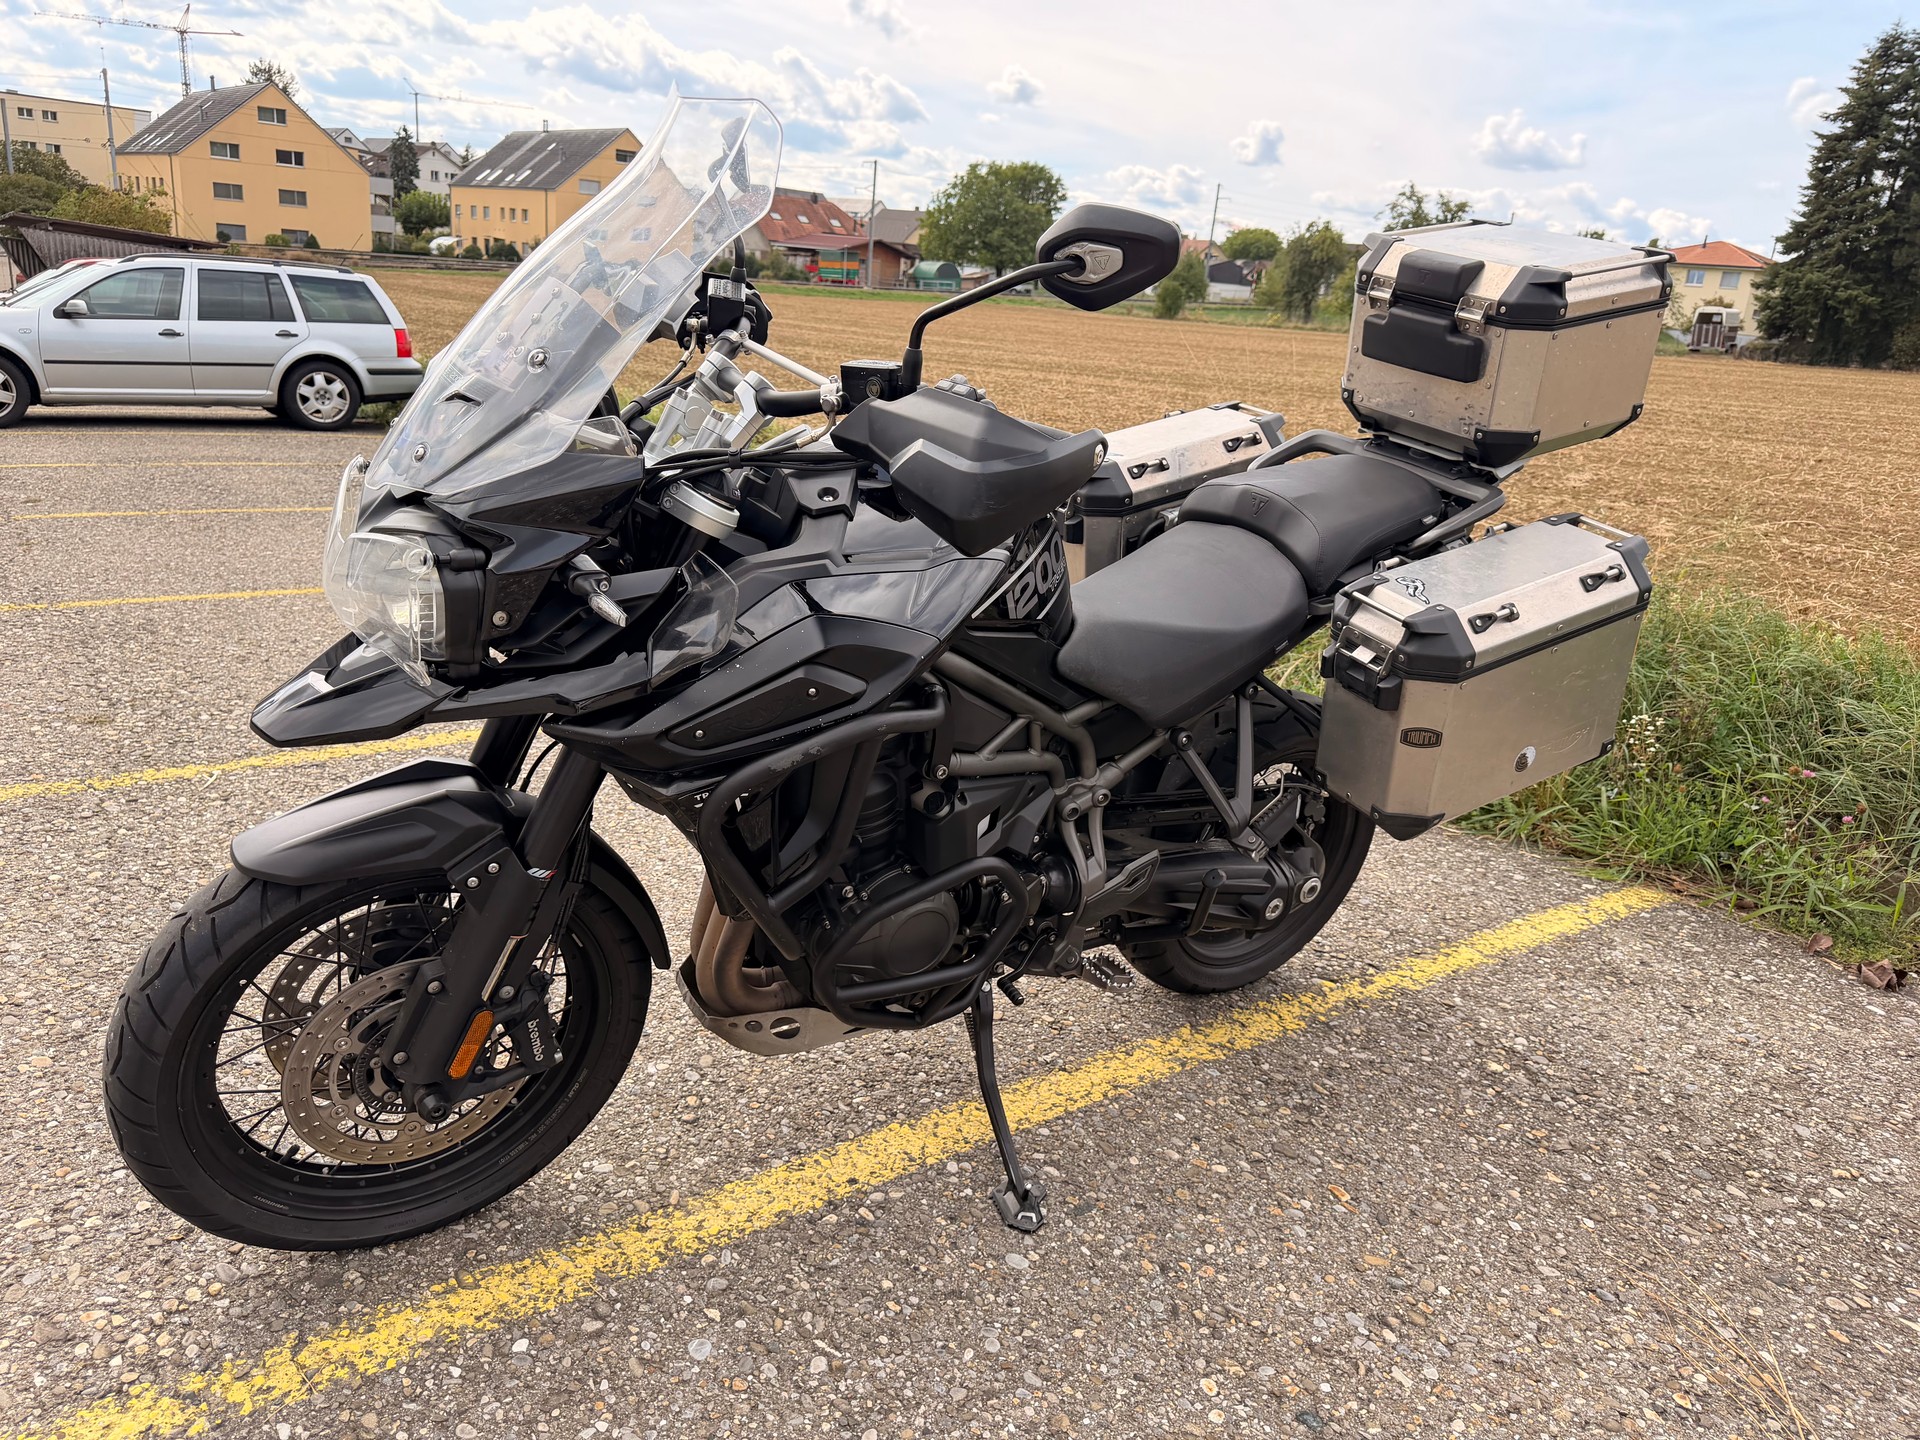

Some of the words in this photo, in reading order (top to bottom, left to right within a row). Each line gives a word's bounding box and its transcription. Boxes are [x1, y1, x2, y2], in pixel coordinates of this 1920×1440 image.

[1006, 531, 1063, 619] 1200
[1407, 731, 1437, 745] TRIUMPH
[527, 1018, 545, 1061] brembo
